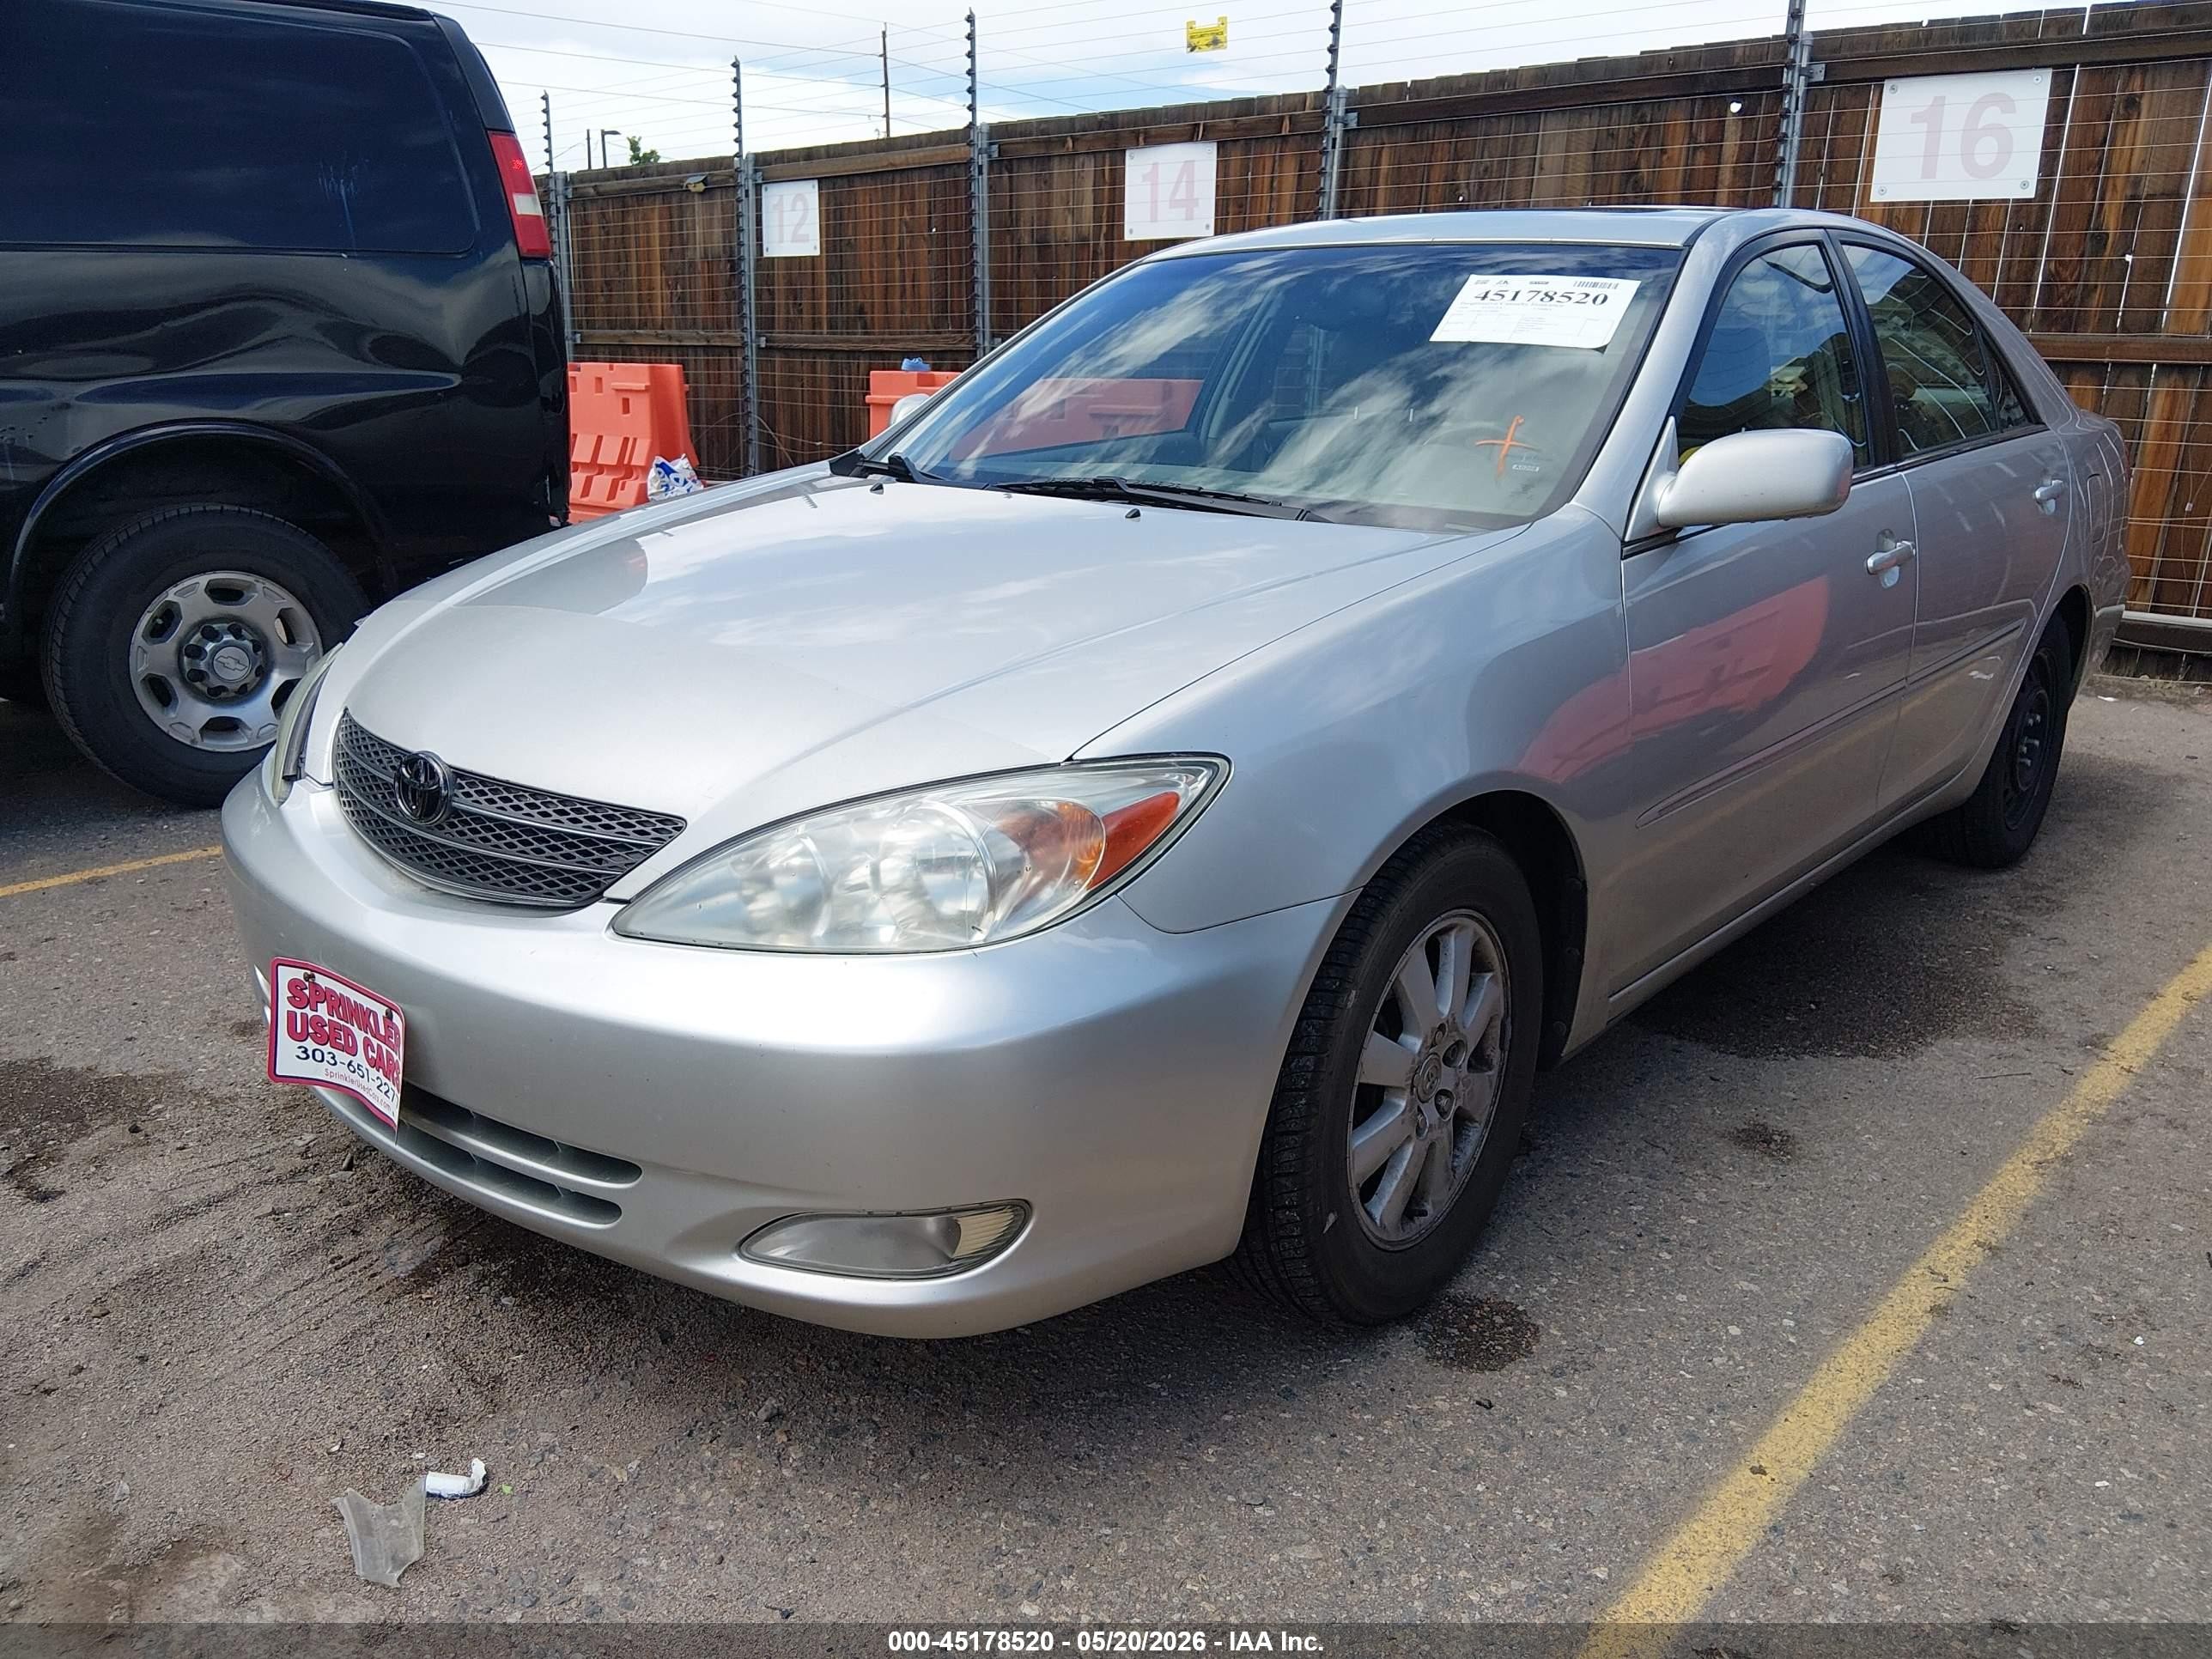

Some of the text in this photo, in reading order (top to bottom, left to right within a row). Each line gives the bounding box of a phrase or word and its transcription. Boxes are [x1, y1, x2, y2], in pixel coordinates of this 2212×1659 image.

[1911, 92, 2017, 179] 16
[773, 193, 810, 244] 12
[1141, 160, 1199, 222] 14
[1474, 289, 1608, 307] 45178520
[286, 1010, 401, 1095] USED CARS
